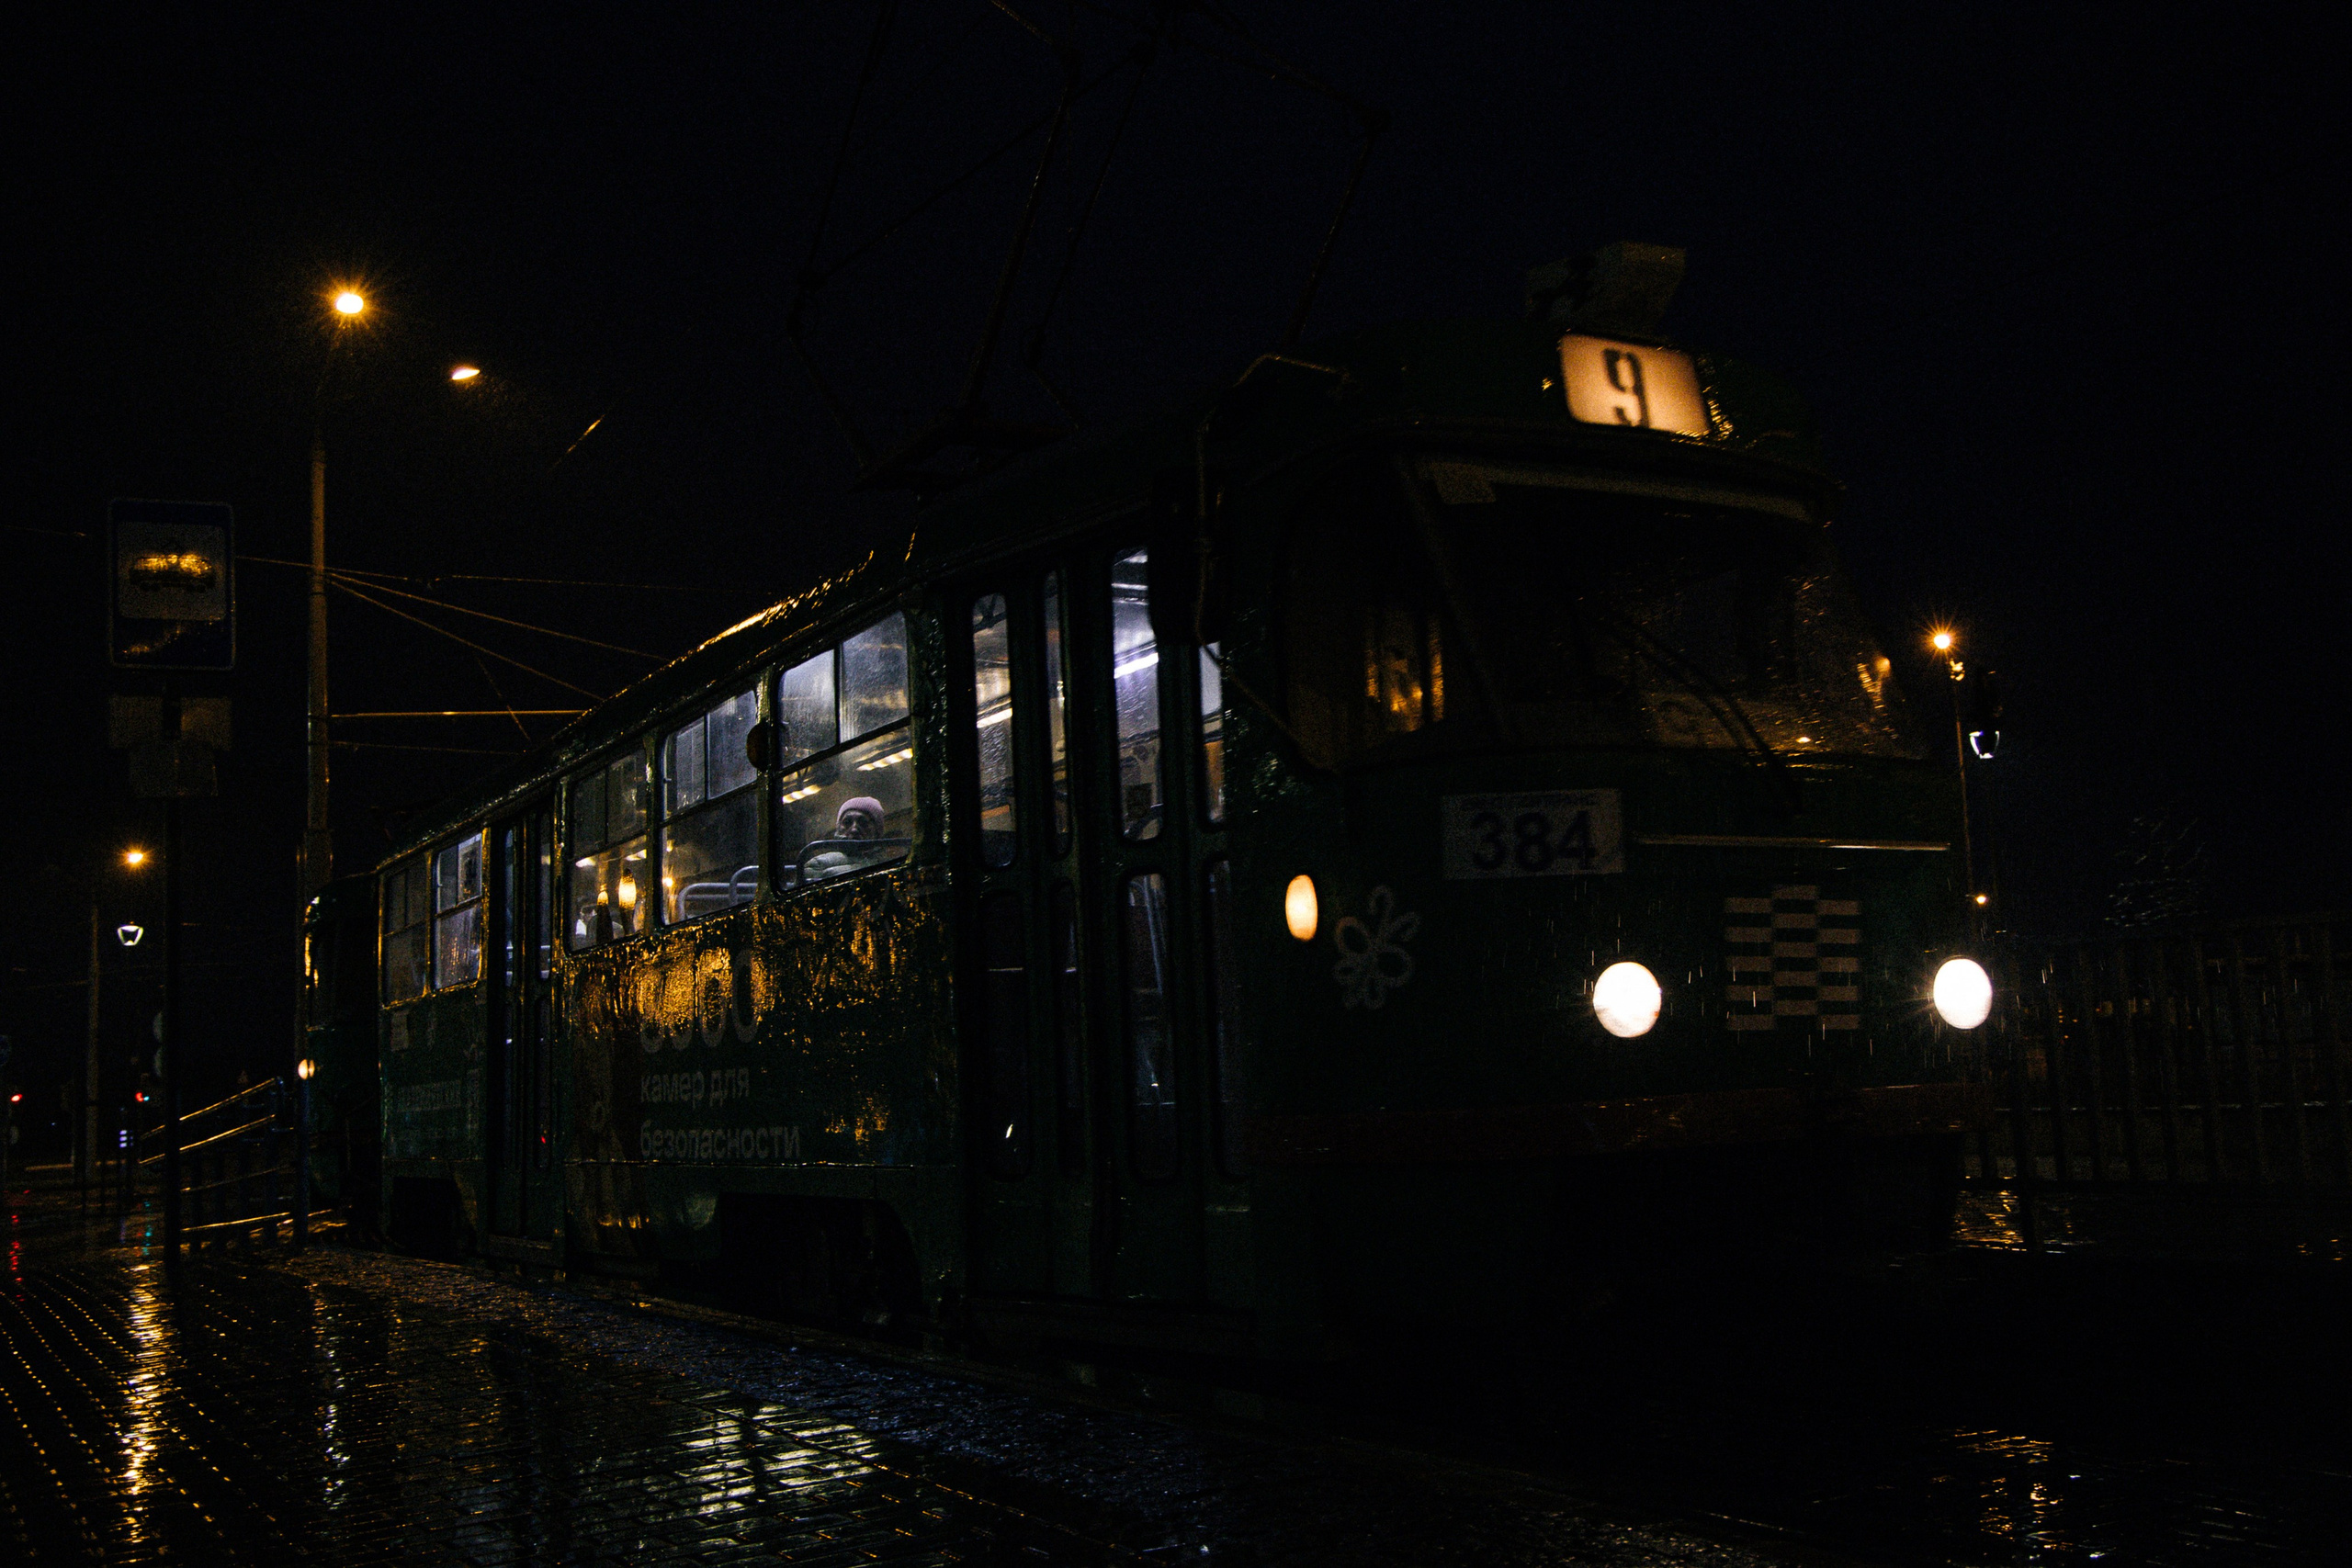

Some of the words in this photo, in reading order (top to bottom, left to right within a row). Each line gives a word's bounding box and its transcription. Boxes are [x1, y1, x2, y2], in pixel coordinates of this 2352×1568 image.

[1602, 346, 1650, 428] 9
[1470, 808, 1597, 872] 384
[640, 1070, 706, 1110] камер
[709, 1066, 750, 1108] для
[639, 1119, 802, 1159] безопасности
